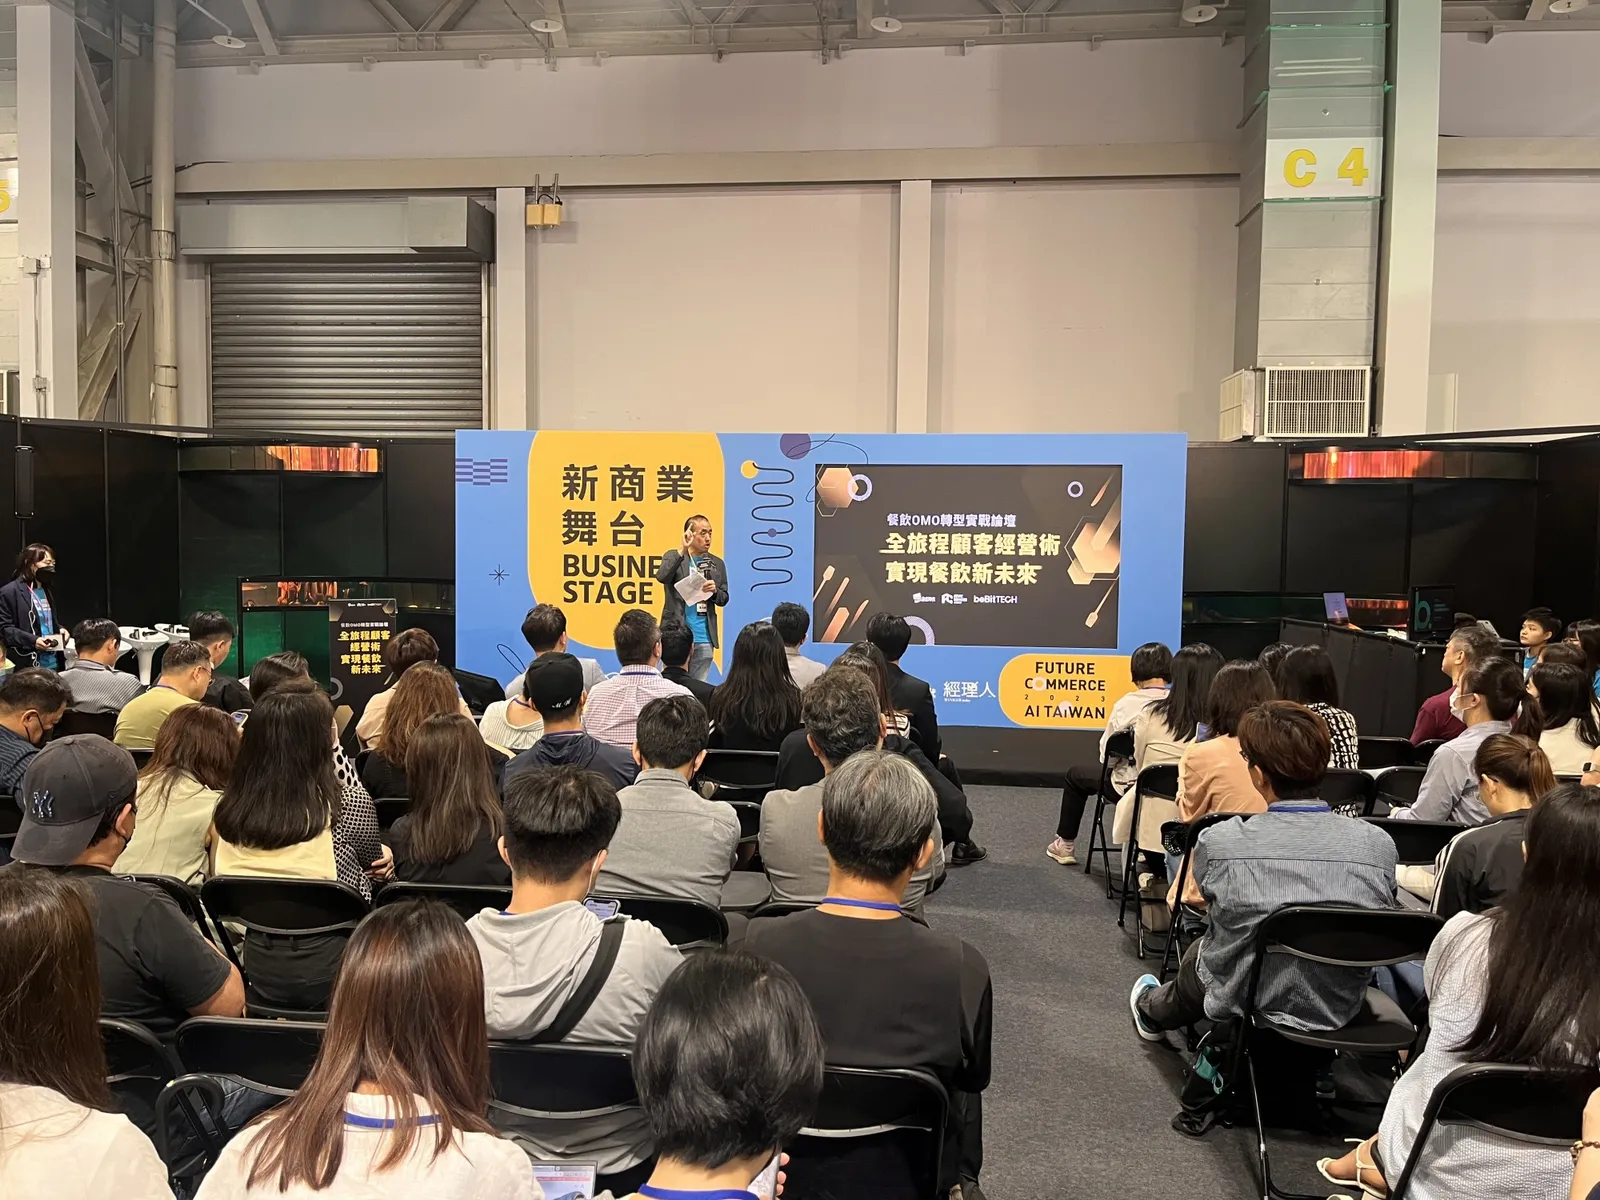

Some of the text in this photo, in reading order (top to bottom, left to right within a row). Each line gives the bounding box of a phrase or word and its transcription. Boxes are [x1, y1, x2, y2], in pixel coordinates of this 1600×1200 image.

[1284, 148, 1369, 188] C 4
[562, 464, 694, 502] 新商業
[887, 513, 1017, 527] 餐飲OMO轉型實戰論壇
[562, 510, 645, 547] 舞台
[879, 532, 1061, 556] 全旅程顧客經營術
[563, 554, 663, 578] BUSINE
[886, 561, 1043, 585] 實現餐飲新未來
[563, 581, 653, 604] STAGE
[337, 630, 391, 641] 全旅程顧客
[350, 642, 381, 652] 經營術
[341, 653, 381, 664] 實現餐飲
[351, 664, 386, 674] 新未來
[1035, 662, 1095, 674] FUTURE
[943, 681, 997, 698] 經理人
[1025, 677, 1105, 691] COMMERCE
[1025, 705, 1040, 717] AI
